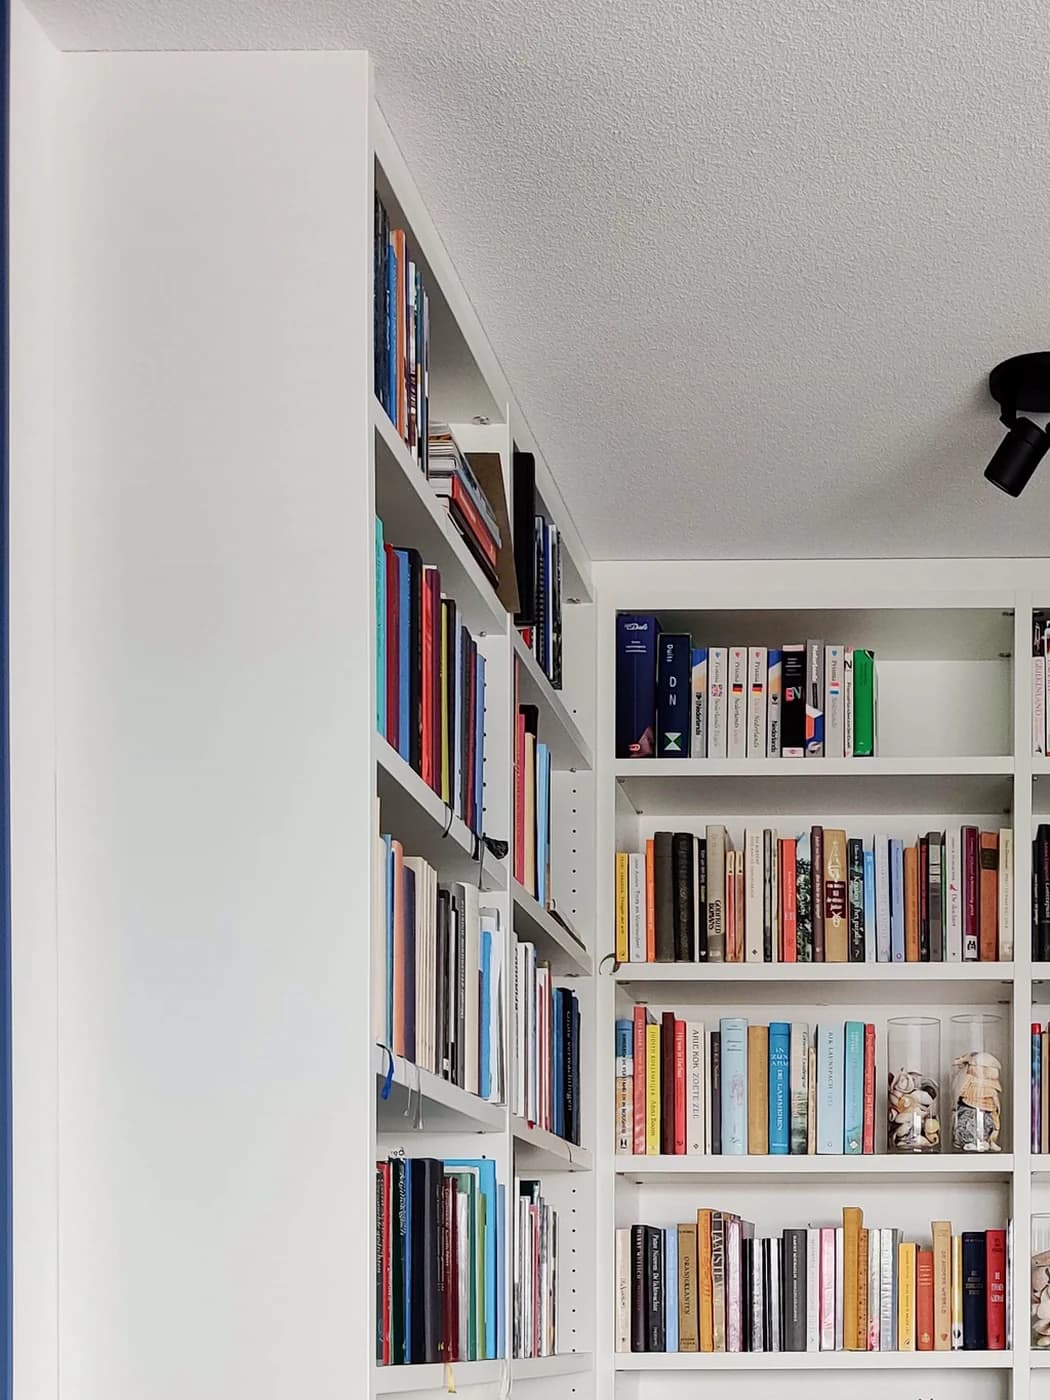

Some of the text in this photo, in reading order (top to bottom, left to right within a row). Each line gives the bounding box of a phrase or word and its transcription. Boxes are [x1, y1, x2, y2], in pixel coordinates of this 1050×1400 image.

[692, 1030, 700, 1049] ARIE
[692, 1051, 700, 1069] KOK
[692, 1072, 700, 1100] ZOETE
